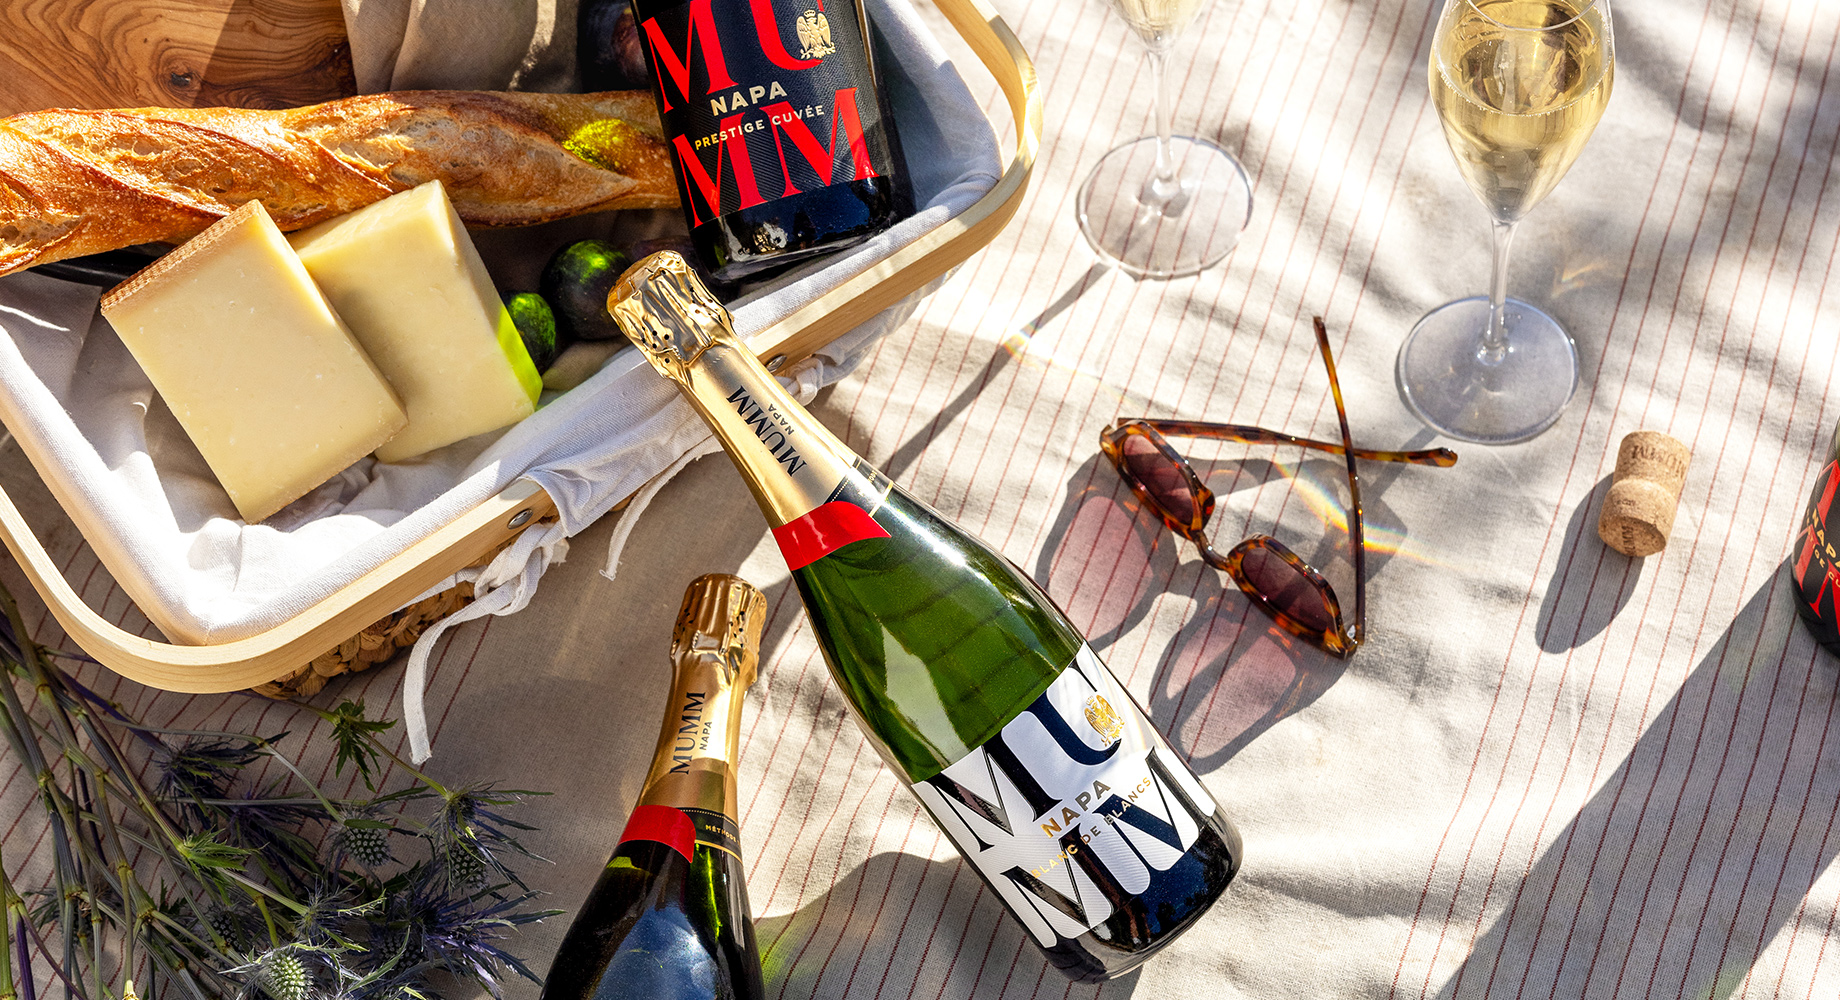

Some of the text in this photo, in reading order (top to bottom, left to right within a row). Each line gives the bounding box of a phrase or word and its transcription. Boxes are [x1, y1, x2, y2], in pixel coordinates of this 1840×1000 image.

[694, 104, 825, 151] PRESTIGE CUVÉE
[710, 81, 788, 116] NAPA
[672, 87, 880, 228] MM
[725, 385, 807, 477] MUMM
[768, 403, 795, 435] NAPA
[669, 691, 707, 776] MUMM
[699, 720, 713, 752] NAPA
[1031, 776, 1152, 879] BLANC DE BLANCS
[1040, 779, 1111, 838] NAPA
